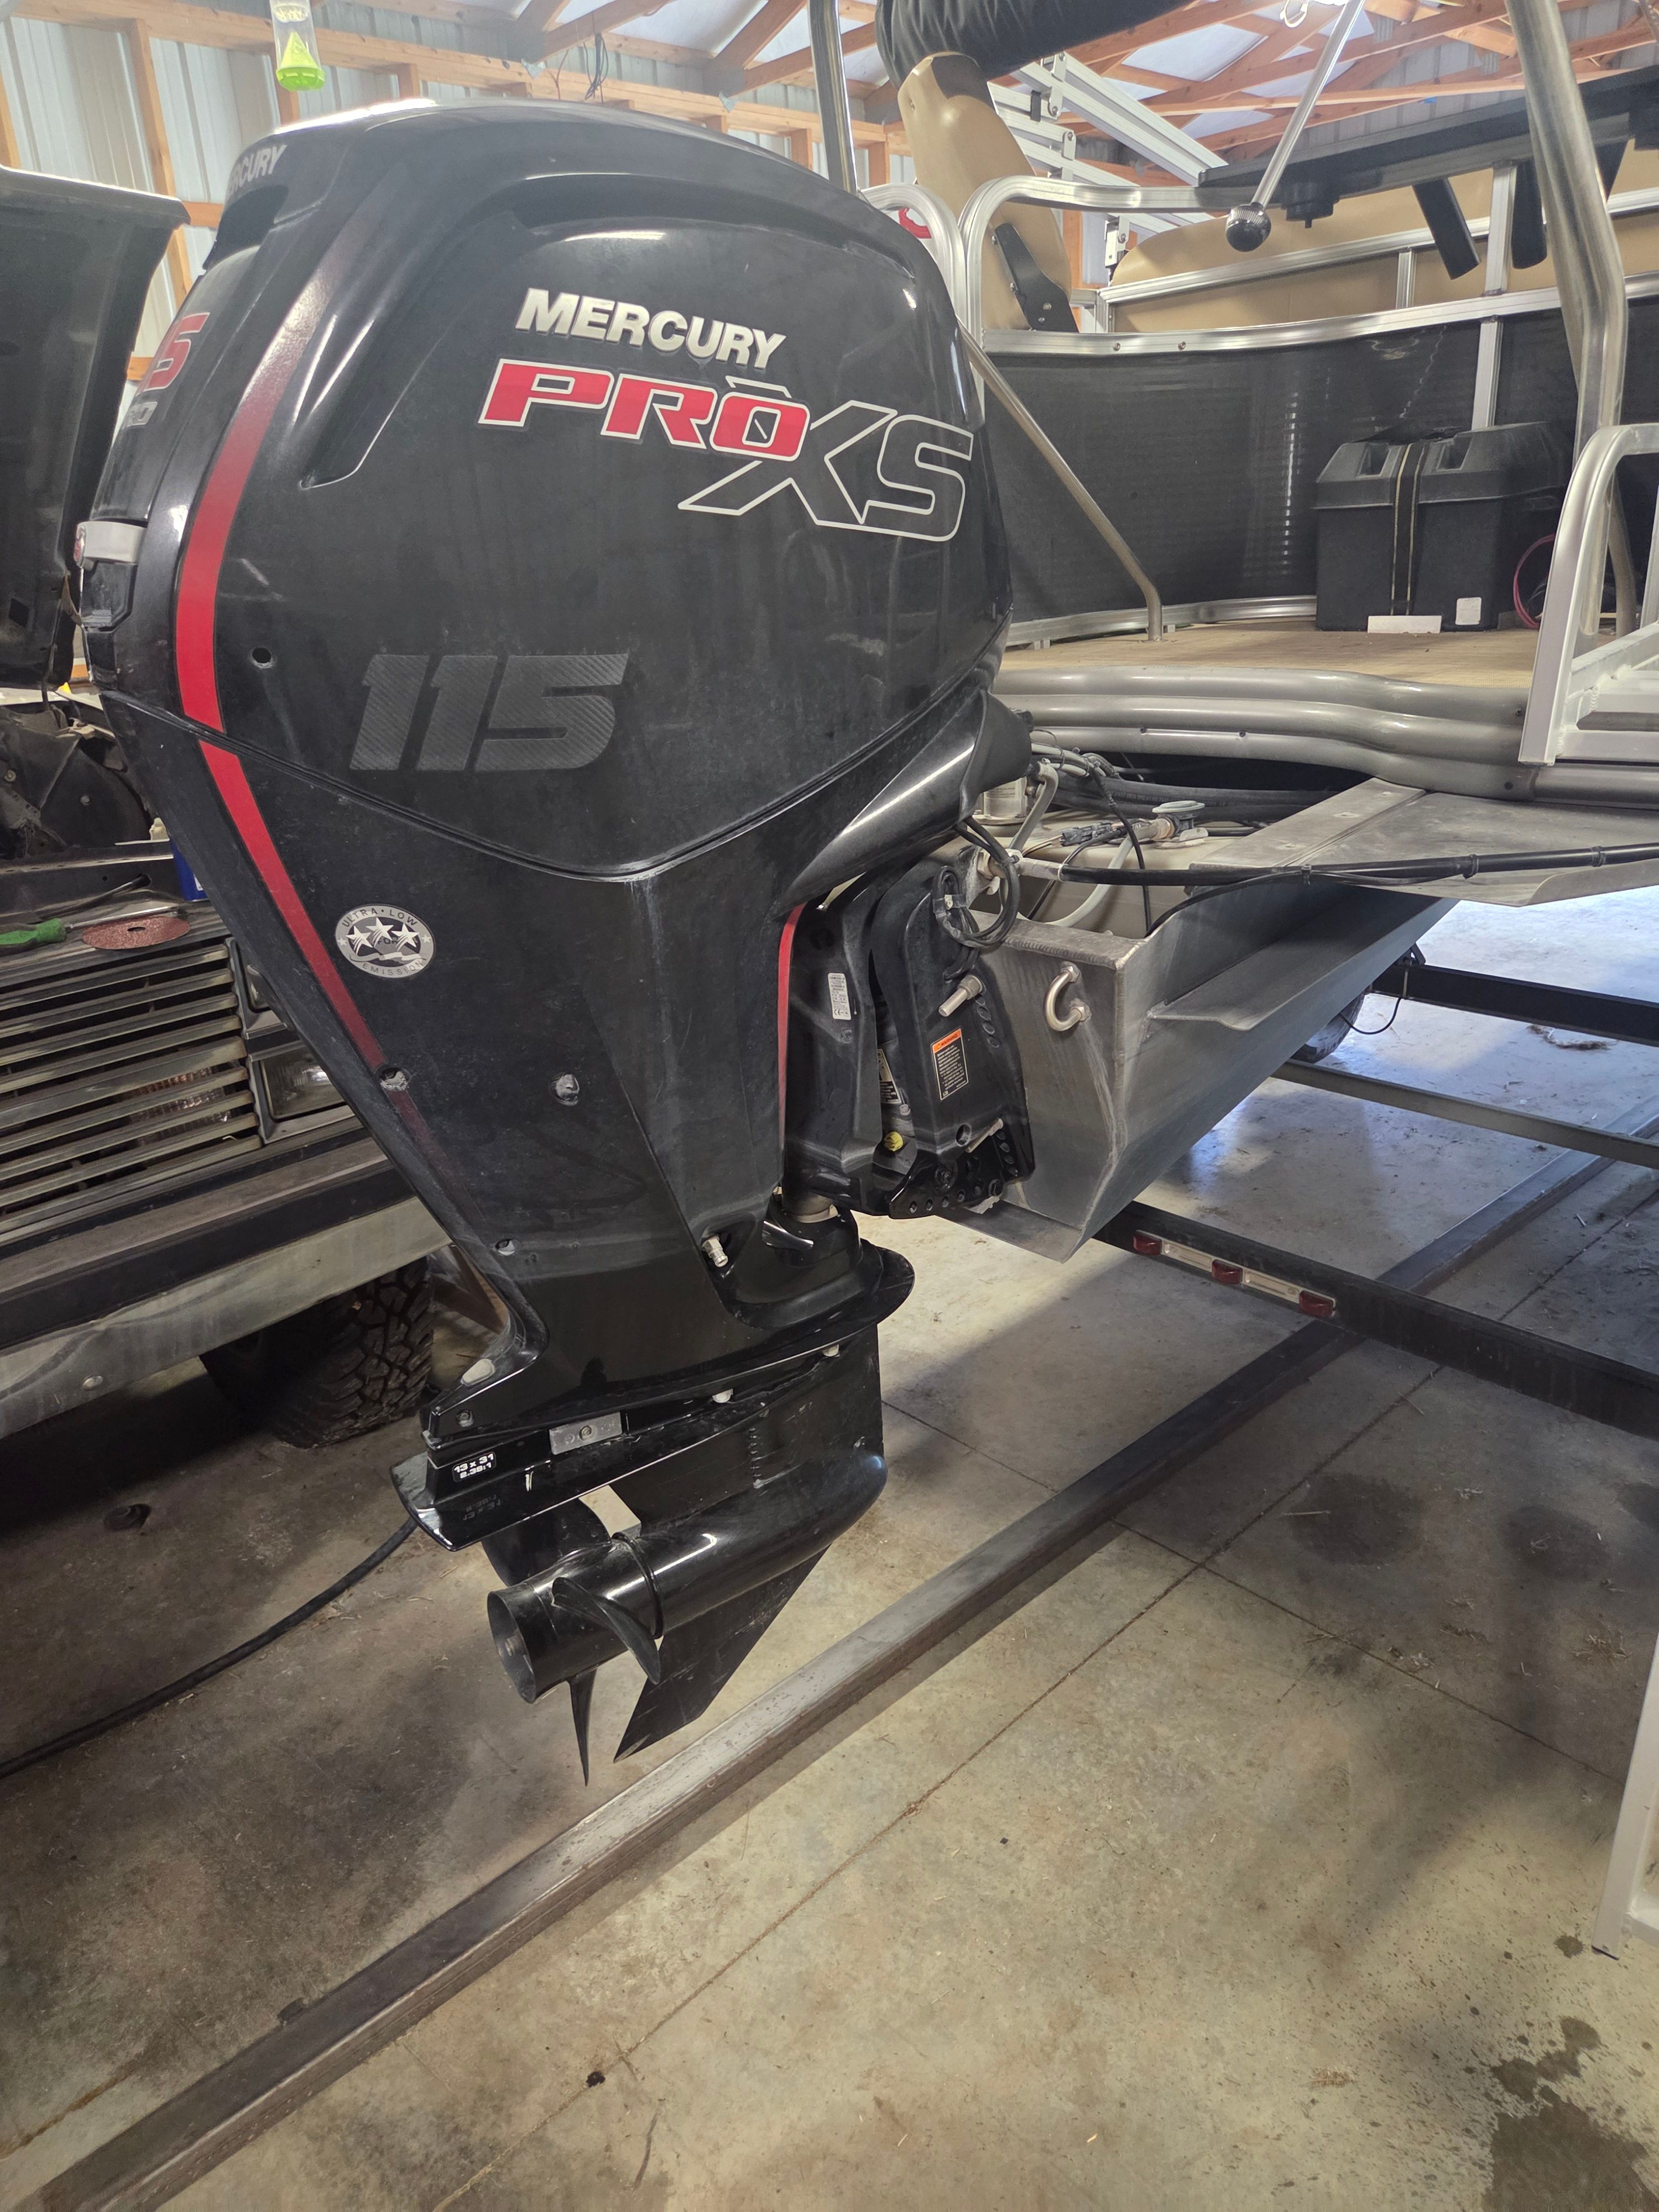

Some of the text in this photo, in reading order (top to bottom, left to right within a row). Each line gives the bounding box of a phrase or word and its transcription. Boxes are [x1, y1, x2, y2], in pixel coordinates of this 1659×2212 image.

[515, 288, 786, 370] MERCURY
[478, 358, 974, 542] PRO XS
[349, 653, 629, 771] 115
[341, 907, 418, 927] ULTRA LOW
[362, 961, 425, 975] EMISSION
[454, 1463, 468, 1473] 13
[479, 1453, 494, 1464] 31
